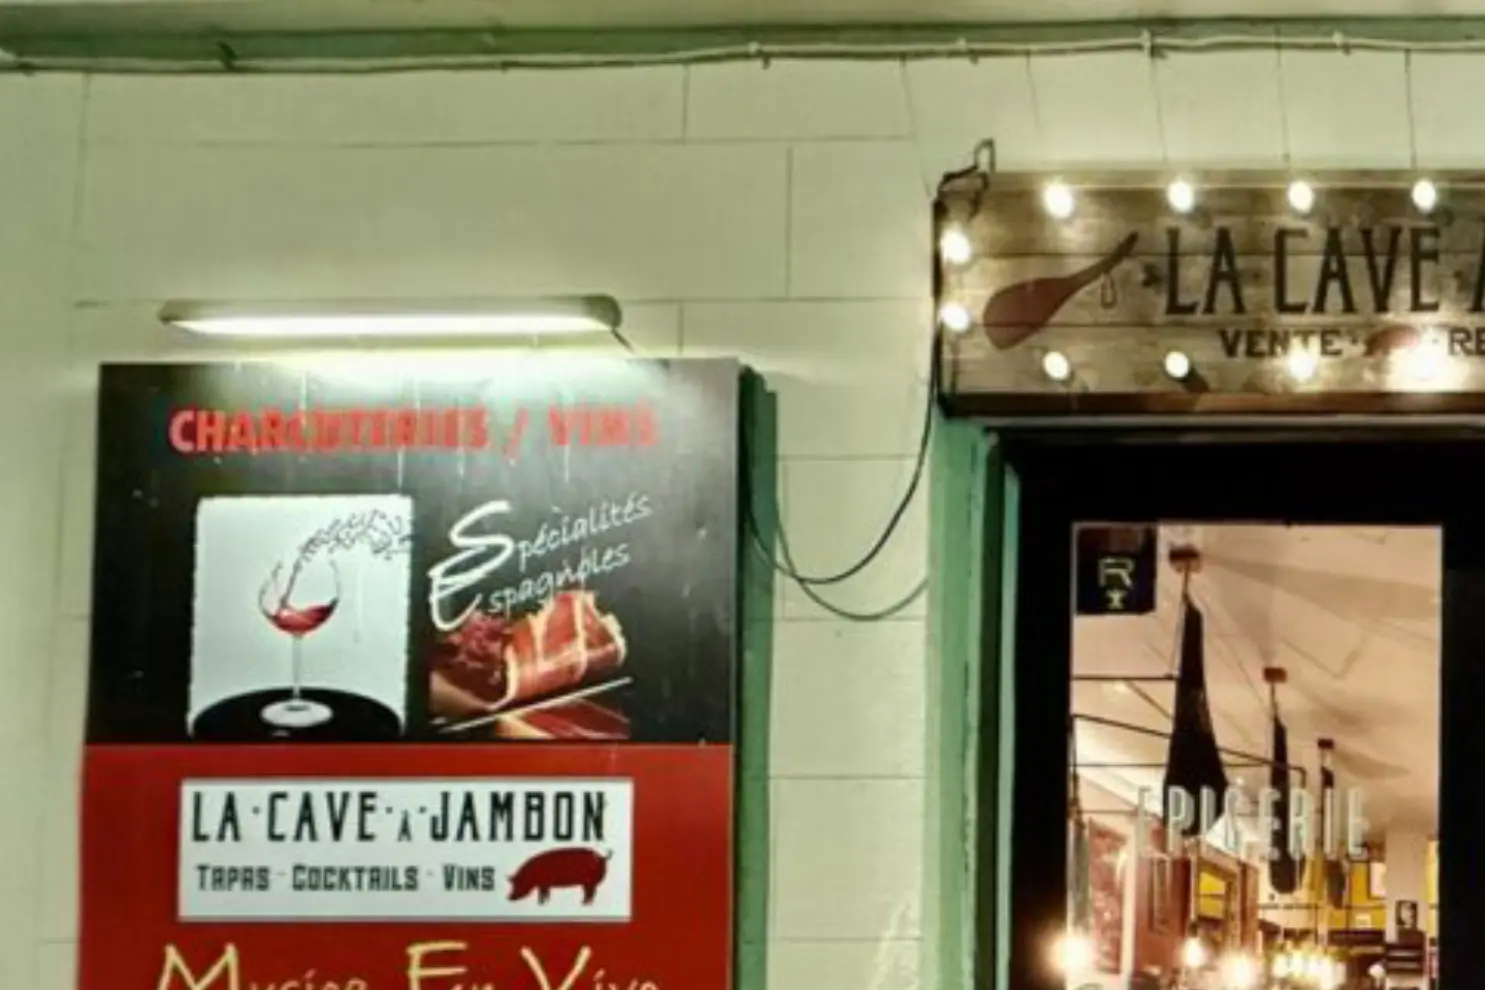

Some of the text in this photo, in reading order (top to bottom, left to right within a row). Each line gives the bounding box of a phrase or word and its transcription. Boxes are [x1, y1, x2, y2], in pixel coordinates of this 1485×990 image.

[1165, 226, 1246, 315] LA
[1274, 226, 1441, 313] CAVE
[192, 791, 242, 842] LA
[266, 791, 378, 842] CAVE
[430, 791, 607, 842] JAMBON
[197, 863, 496, 892] TAPAS COCKTAILS VINS
